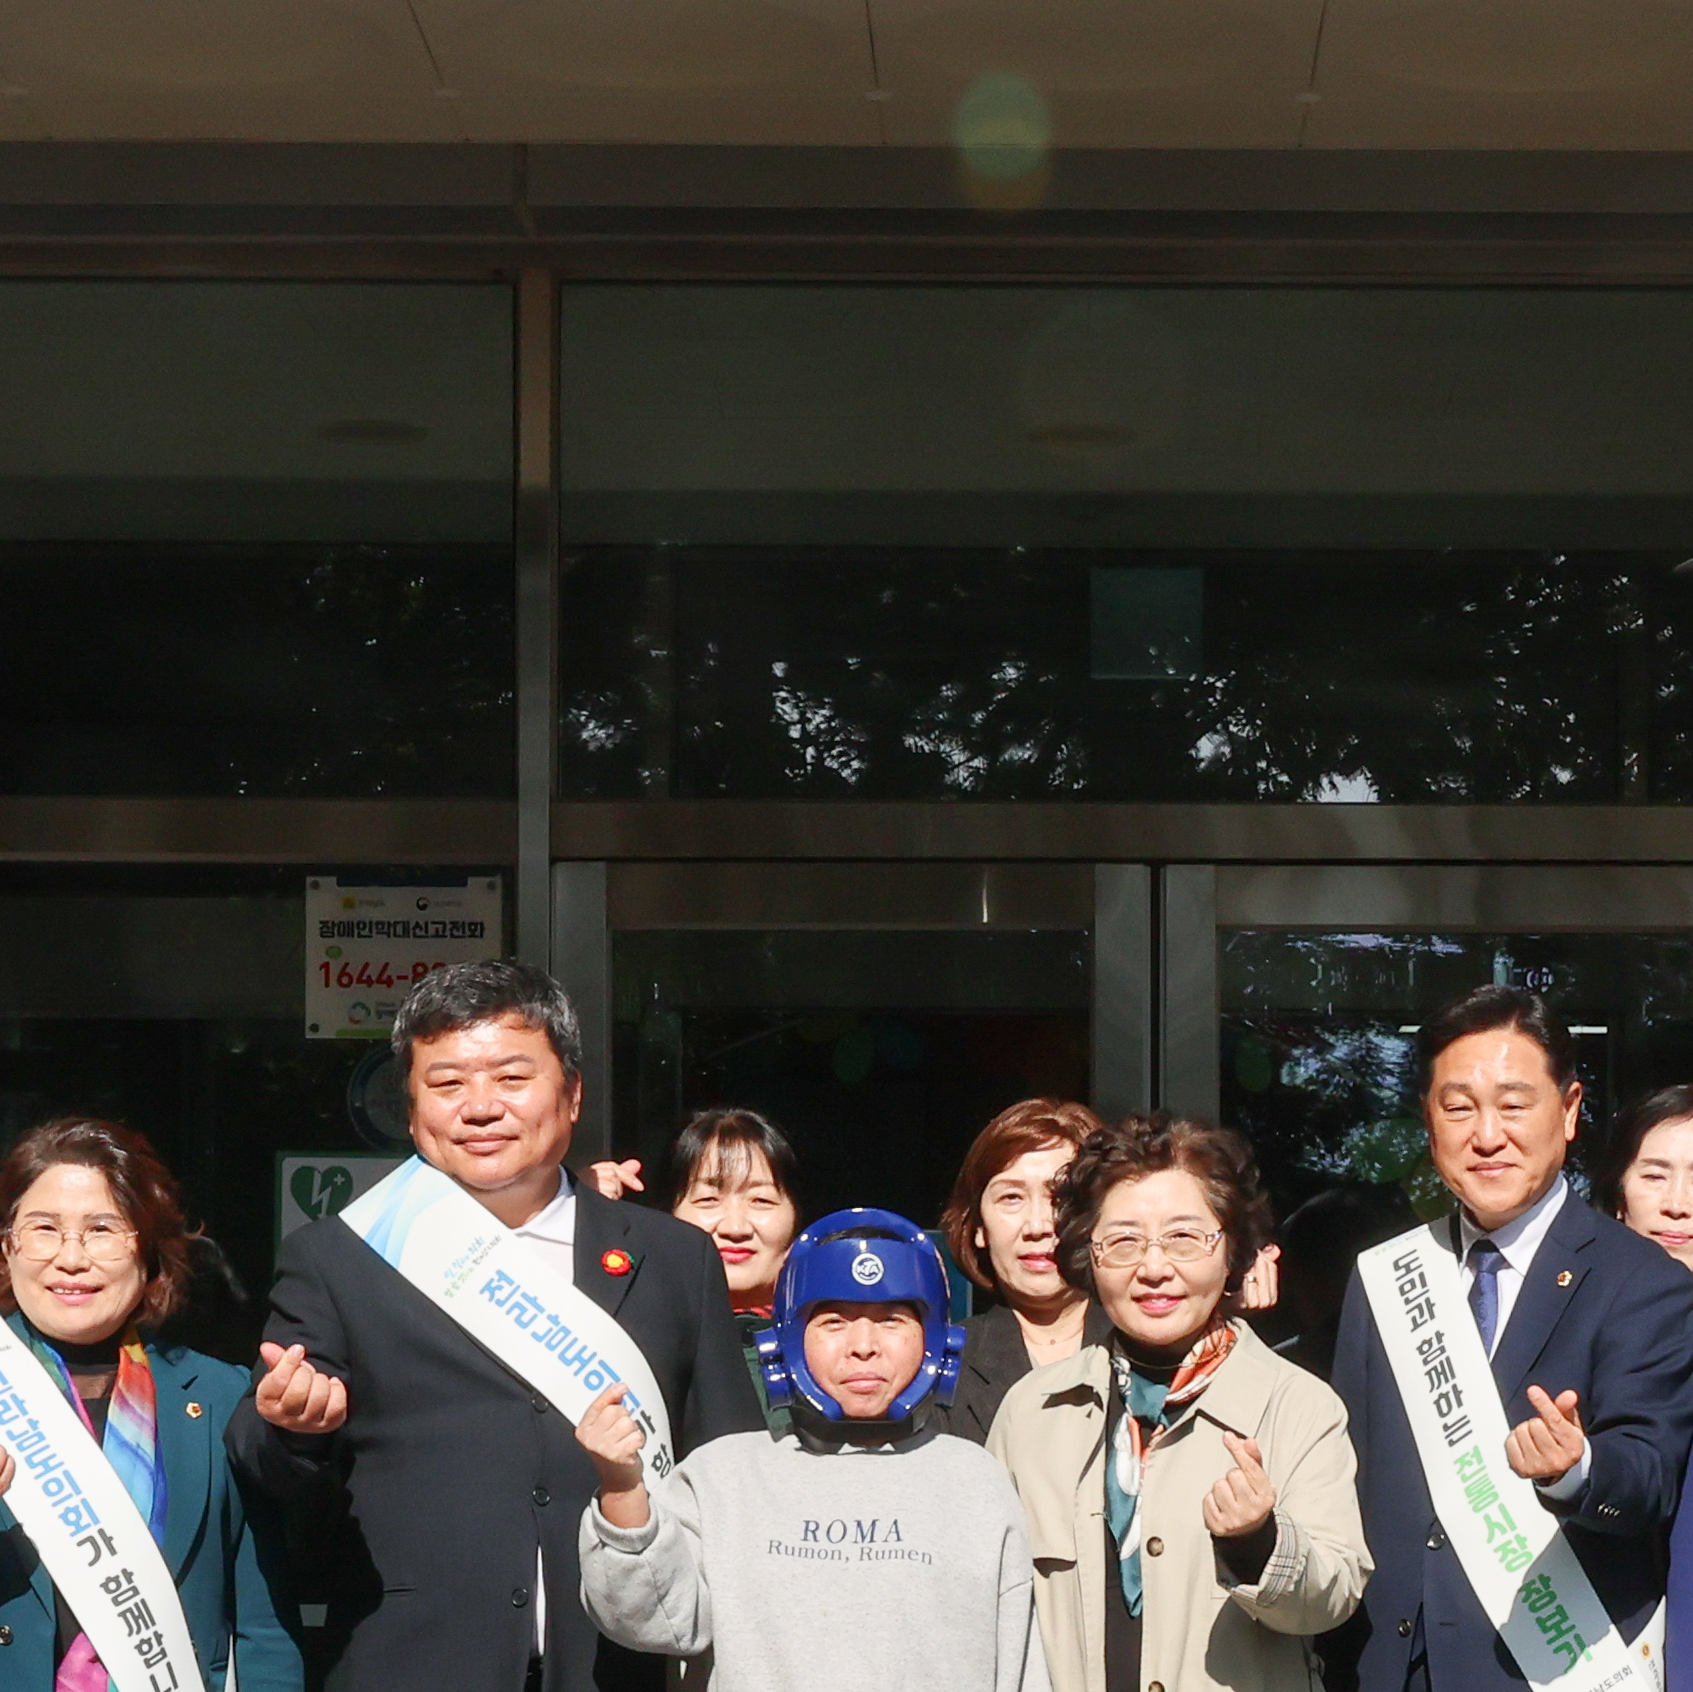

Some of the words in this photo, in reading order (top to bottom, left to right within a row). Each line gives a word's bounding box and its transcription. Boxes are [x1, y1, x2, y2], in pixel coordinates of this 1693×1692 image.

[319, 920, 485, 939] 장애인학대신고전화
[318, 962, 447, 988] 1644-8
[1393, 1248, 1437, 1333] 도민과
[1415, 1329, 1473, 1449] 함께하는
[1453, 1445, 1534, 1574] 전통시장
[1517, 1573, 1593, 1674] 장보기
[800, 1519, 904, 1544] ROMA
[859, 1545, 933, 1565] Rumen
